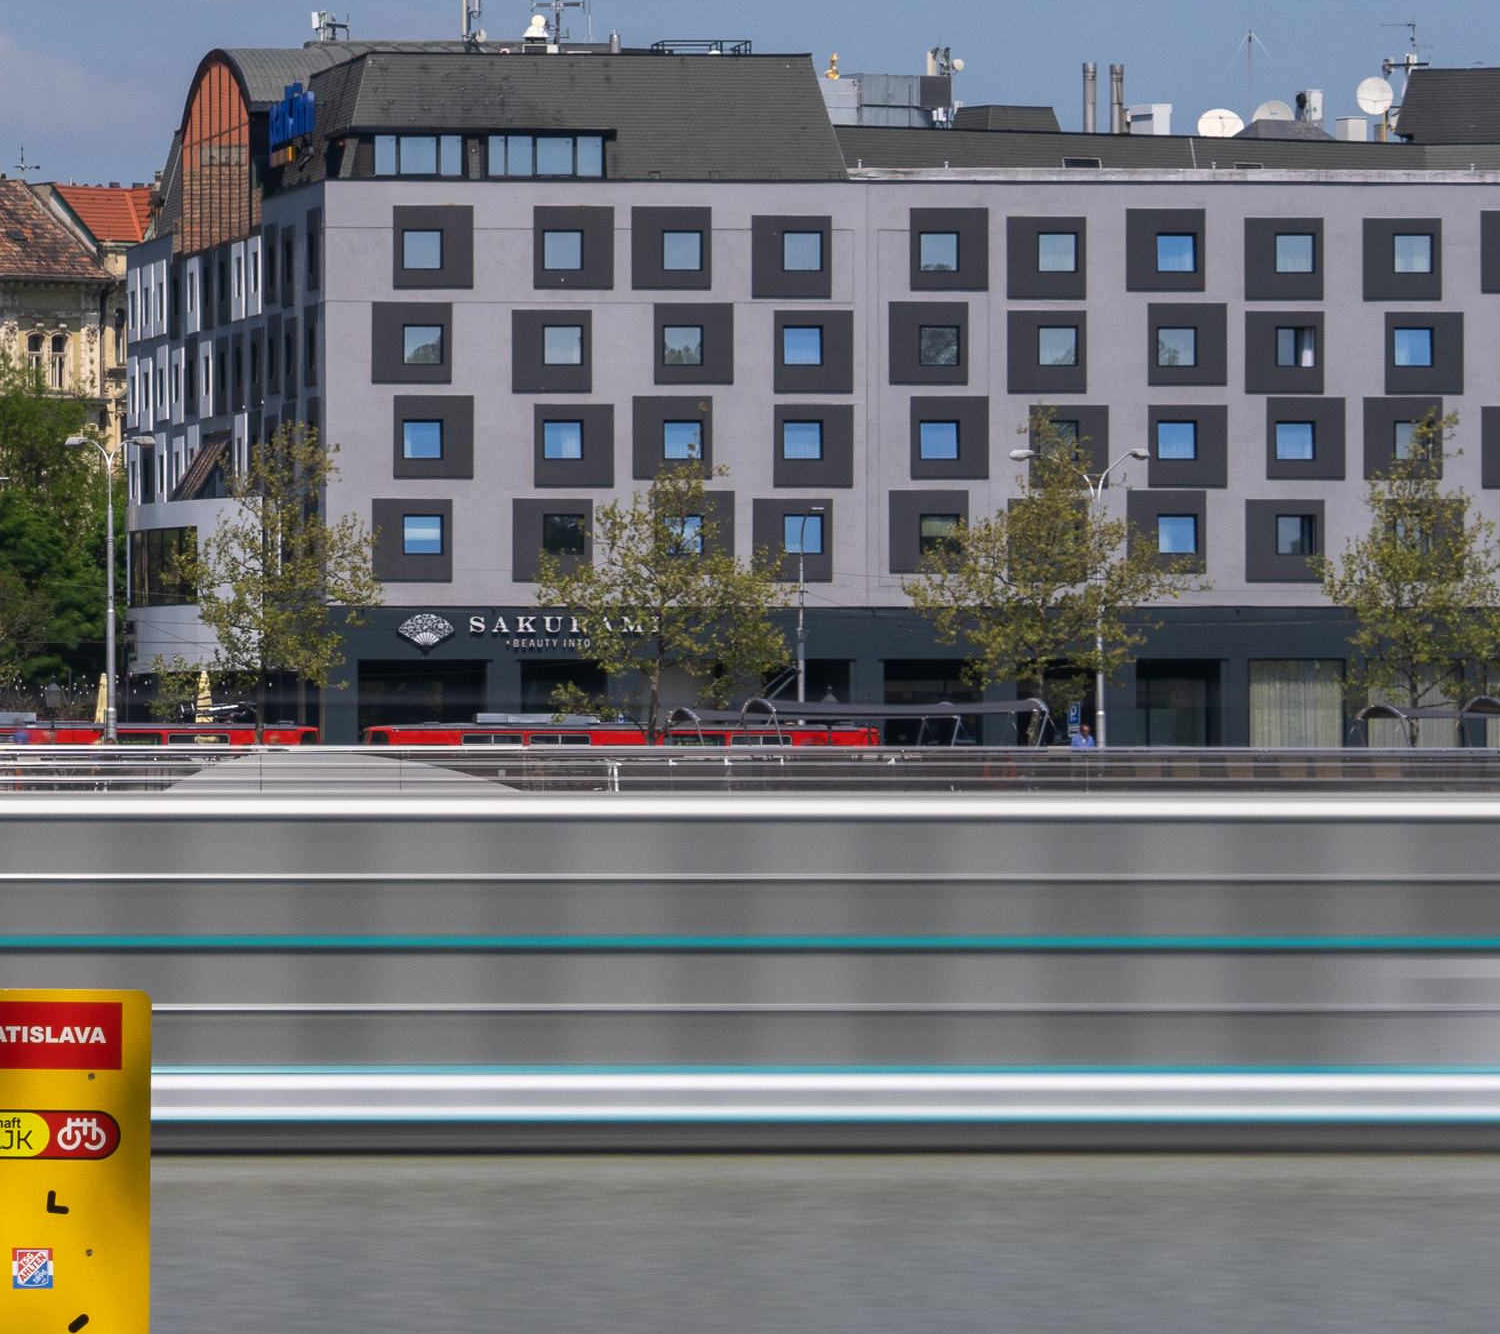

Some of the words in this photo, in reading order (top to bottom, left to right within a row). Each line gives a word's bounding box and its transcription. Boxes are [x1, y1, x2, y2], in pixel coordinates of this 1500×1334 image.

[513, 639, 558, 648] BEAUTY
[563, 639, 591, 648] INTO
[19, 1252, 34, 1267] TSG
[19, 1253, 46, 1282] AHLTEN
[33, 1269, 47, 1284] 1896
